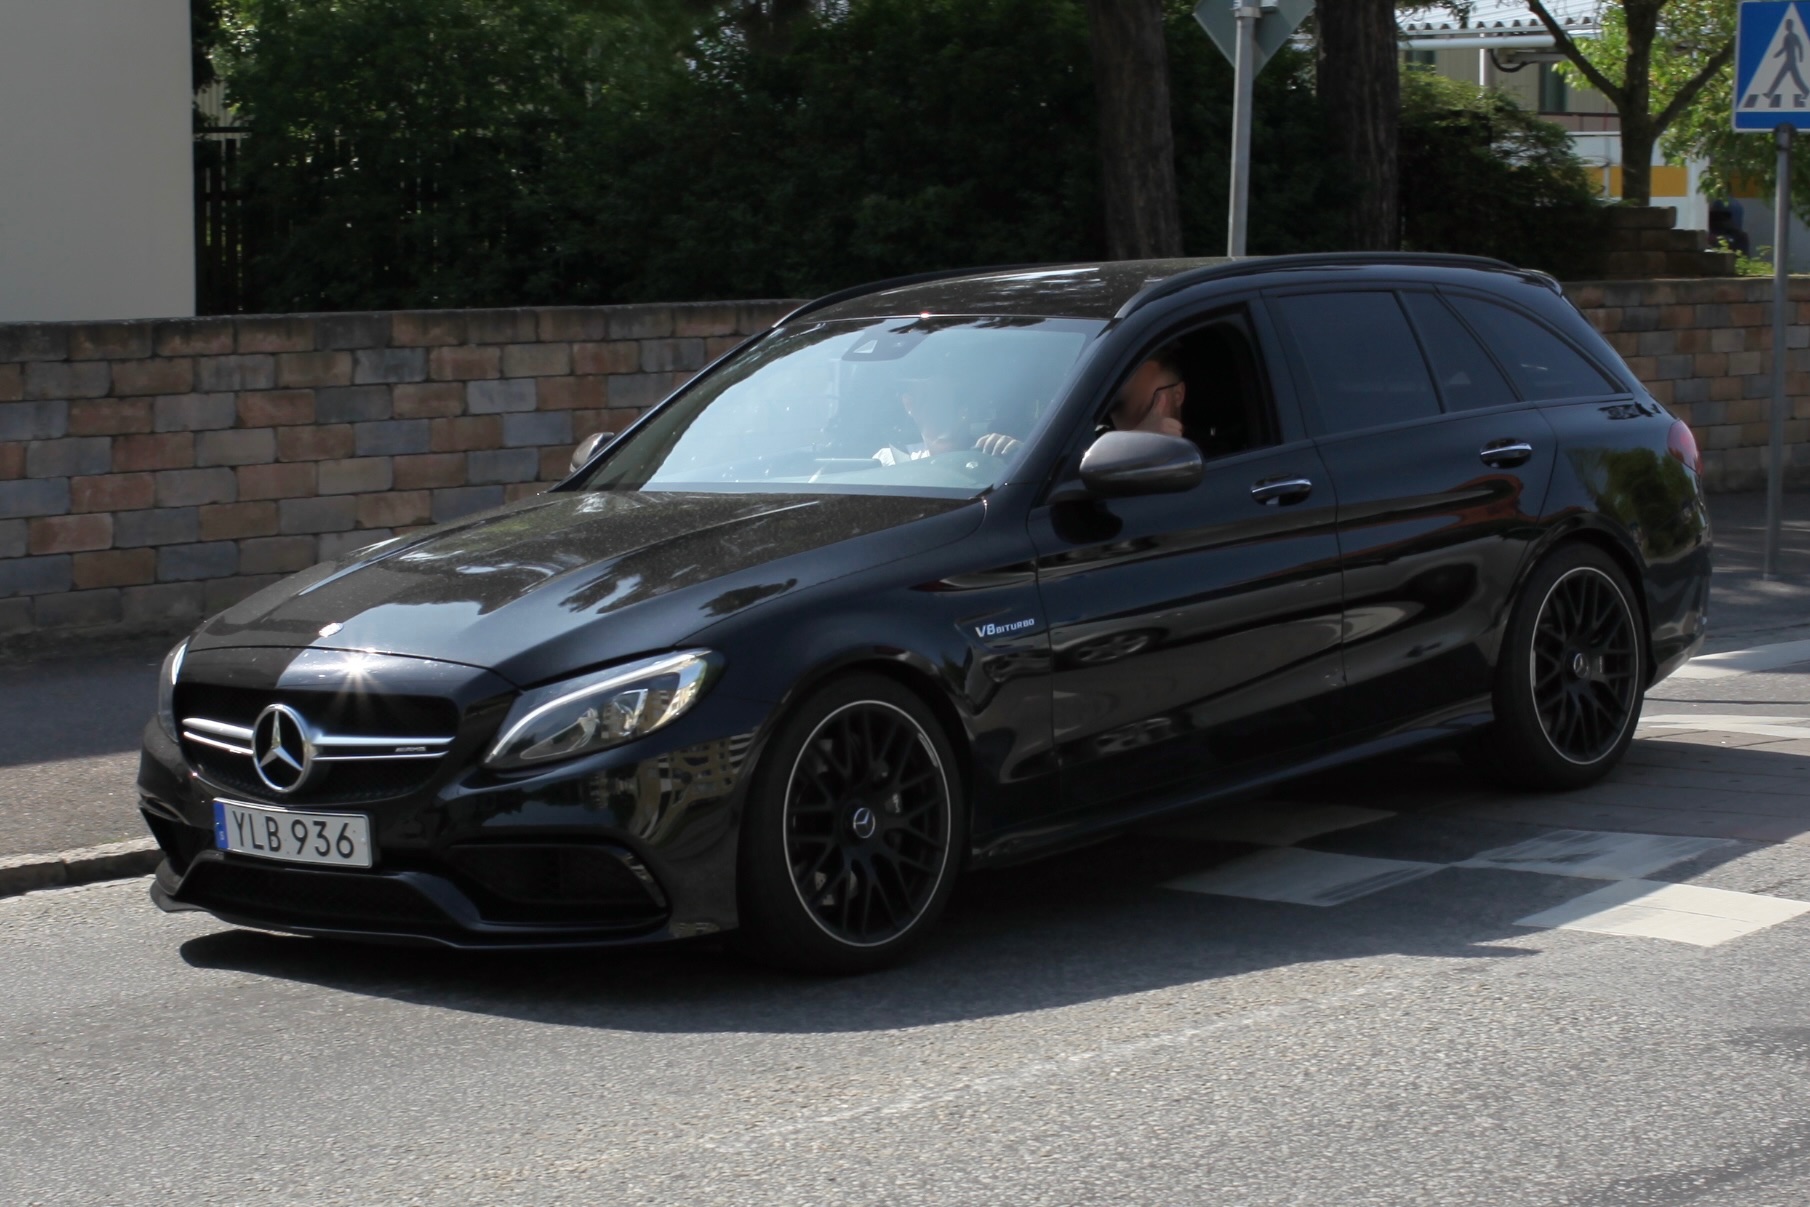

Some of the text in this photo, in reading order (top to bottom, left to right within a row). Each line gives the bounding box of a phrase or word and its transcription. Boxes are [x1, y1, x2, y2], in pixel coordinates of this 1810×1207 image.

[975, 618, 1035, 638] V8 BITURBO
[232, 810, 354, 859] YLB 936
